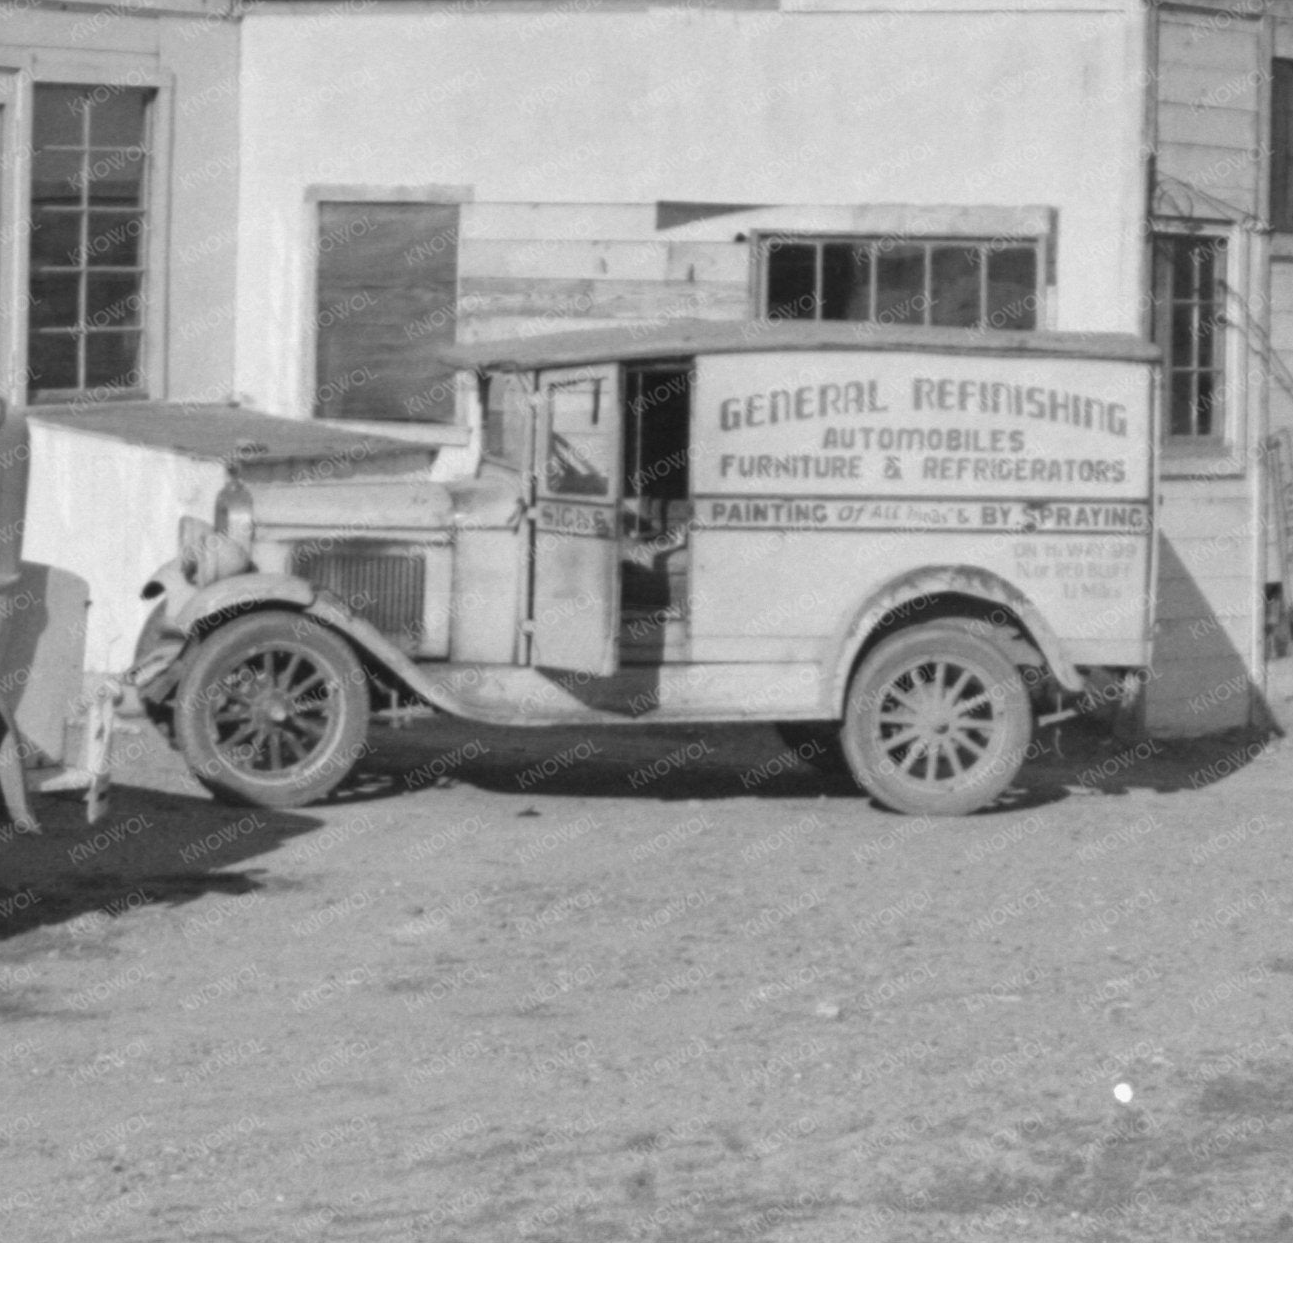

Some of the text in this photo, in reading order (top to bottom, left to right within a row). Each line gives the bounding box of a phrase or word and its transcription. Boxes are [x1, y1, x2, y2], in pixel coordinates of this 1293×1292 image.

[719, 377, 1128, 438] GENERAL REFINISHING
[822, 426, 1026, 453] AUTOMOBILES
[719, 454, 1127, 483] FURNITURE & REFRIGERATORS
[711, 502, 828, 524] PAINTING
[981, 506, 1012, 526] BY
[1021, 506, 1143, 529] SPRAYING
